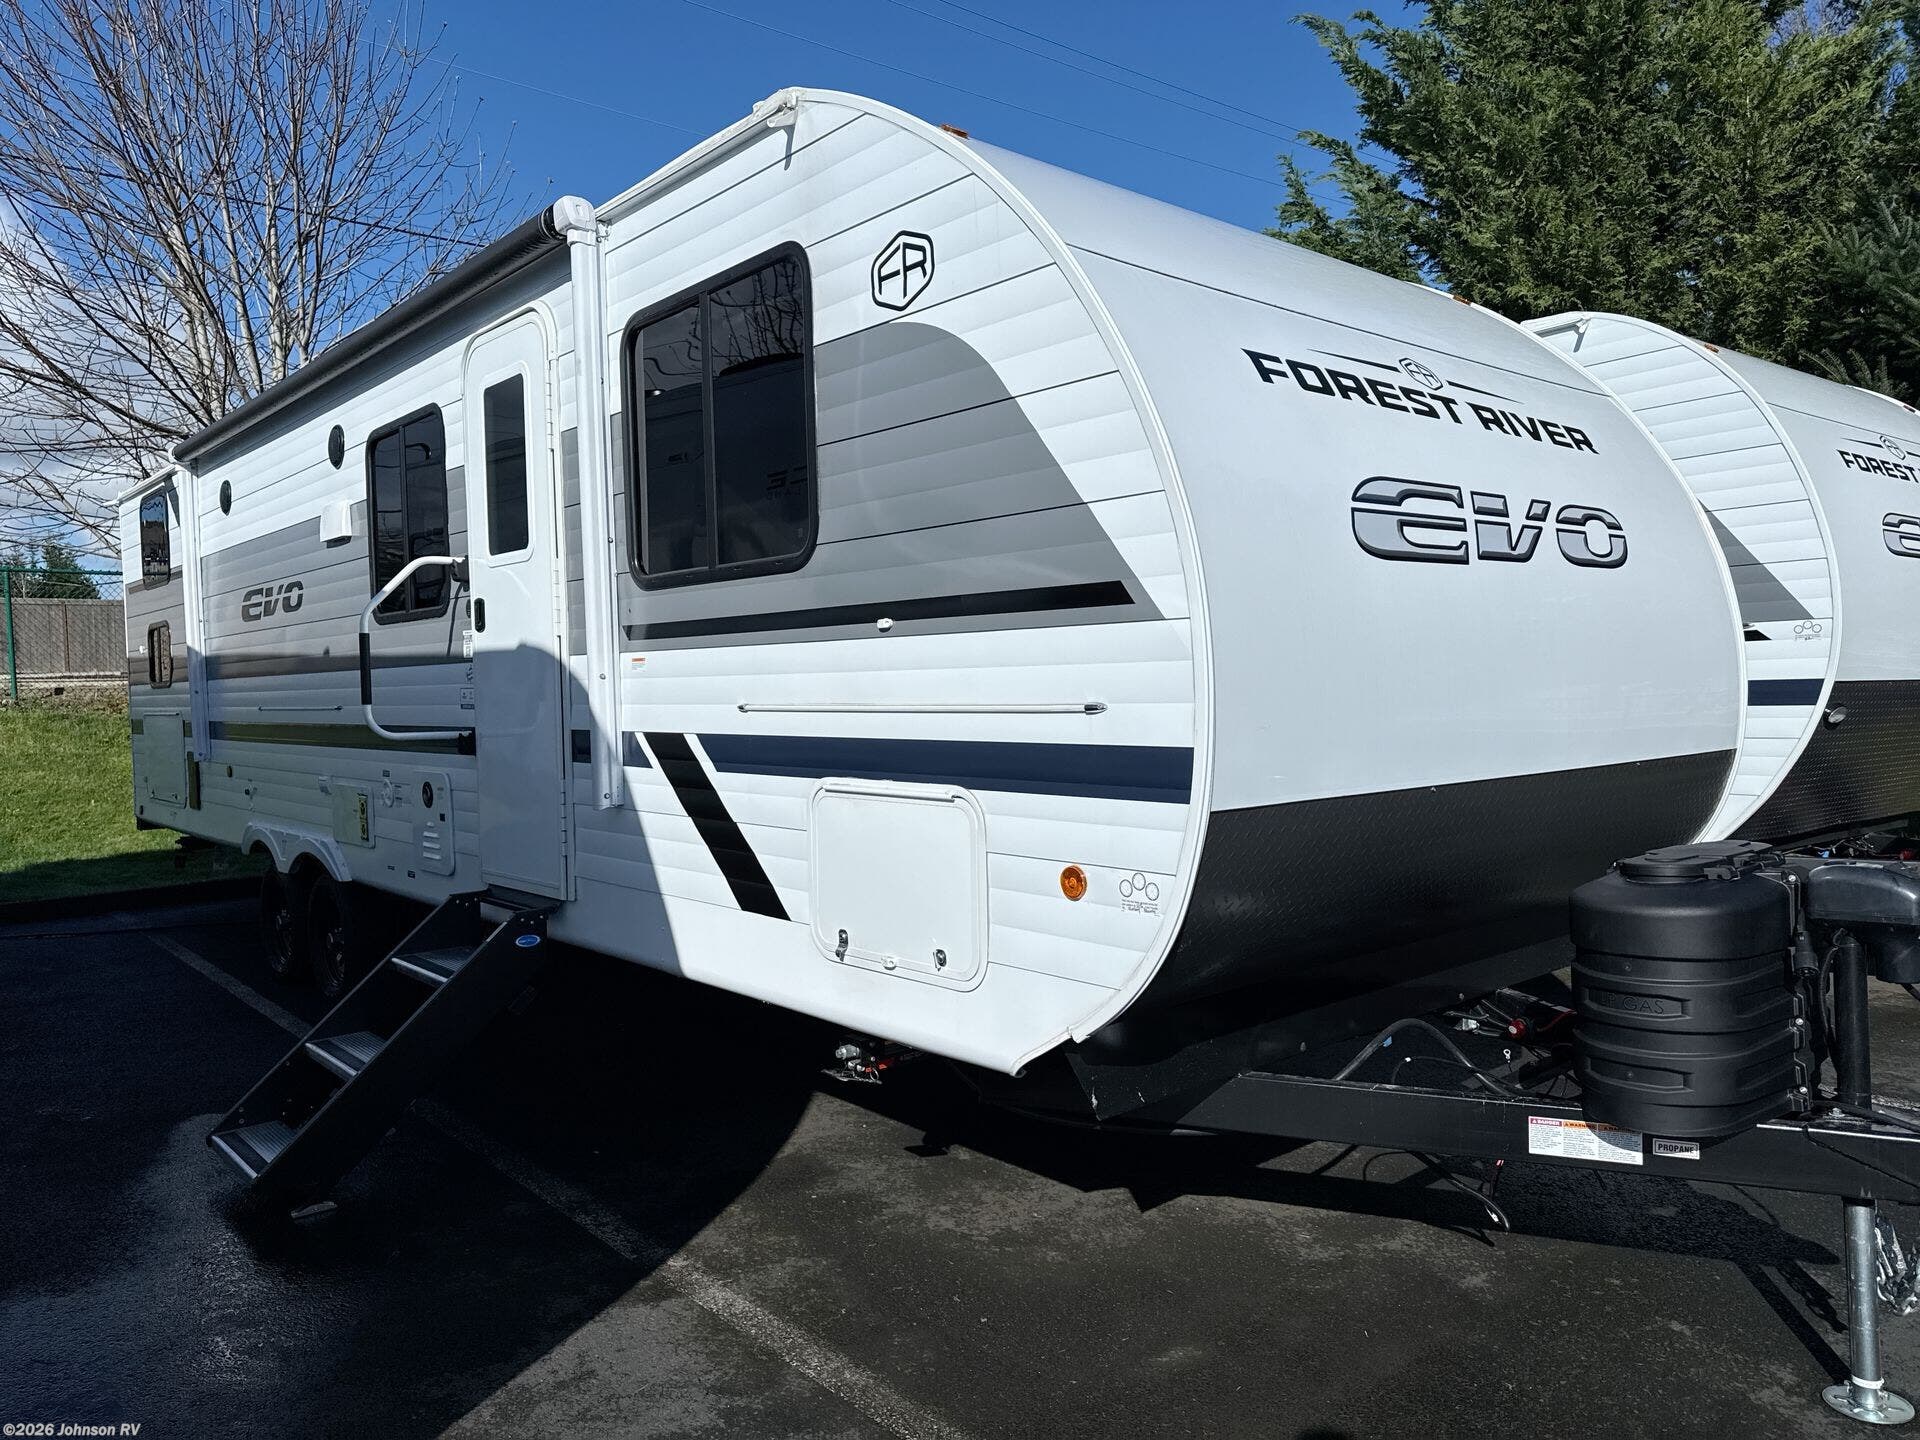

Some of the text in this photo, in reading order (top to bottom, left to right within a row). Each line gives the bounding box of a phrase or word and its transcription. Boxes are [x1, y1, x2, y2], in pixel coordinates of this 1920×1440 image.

[1240, 348, 1600, 454] FOREST RIVER
[1835, 448, 1919, 484] FOREST
[1351, 476, 1628, 569] EVO
[241, 580, 304, 622] EVO
[1622, 995, 1664, 1014] GAS
[1657, 1143, 1695, 1153] PROPANE
